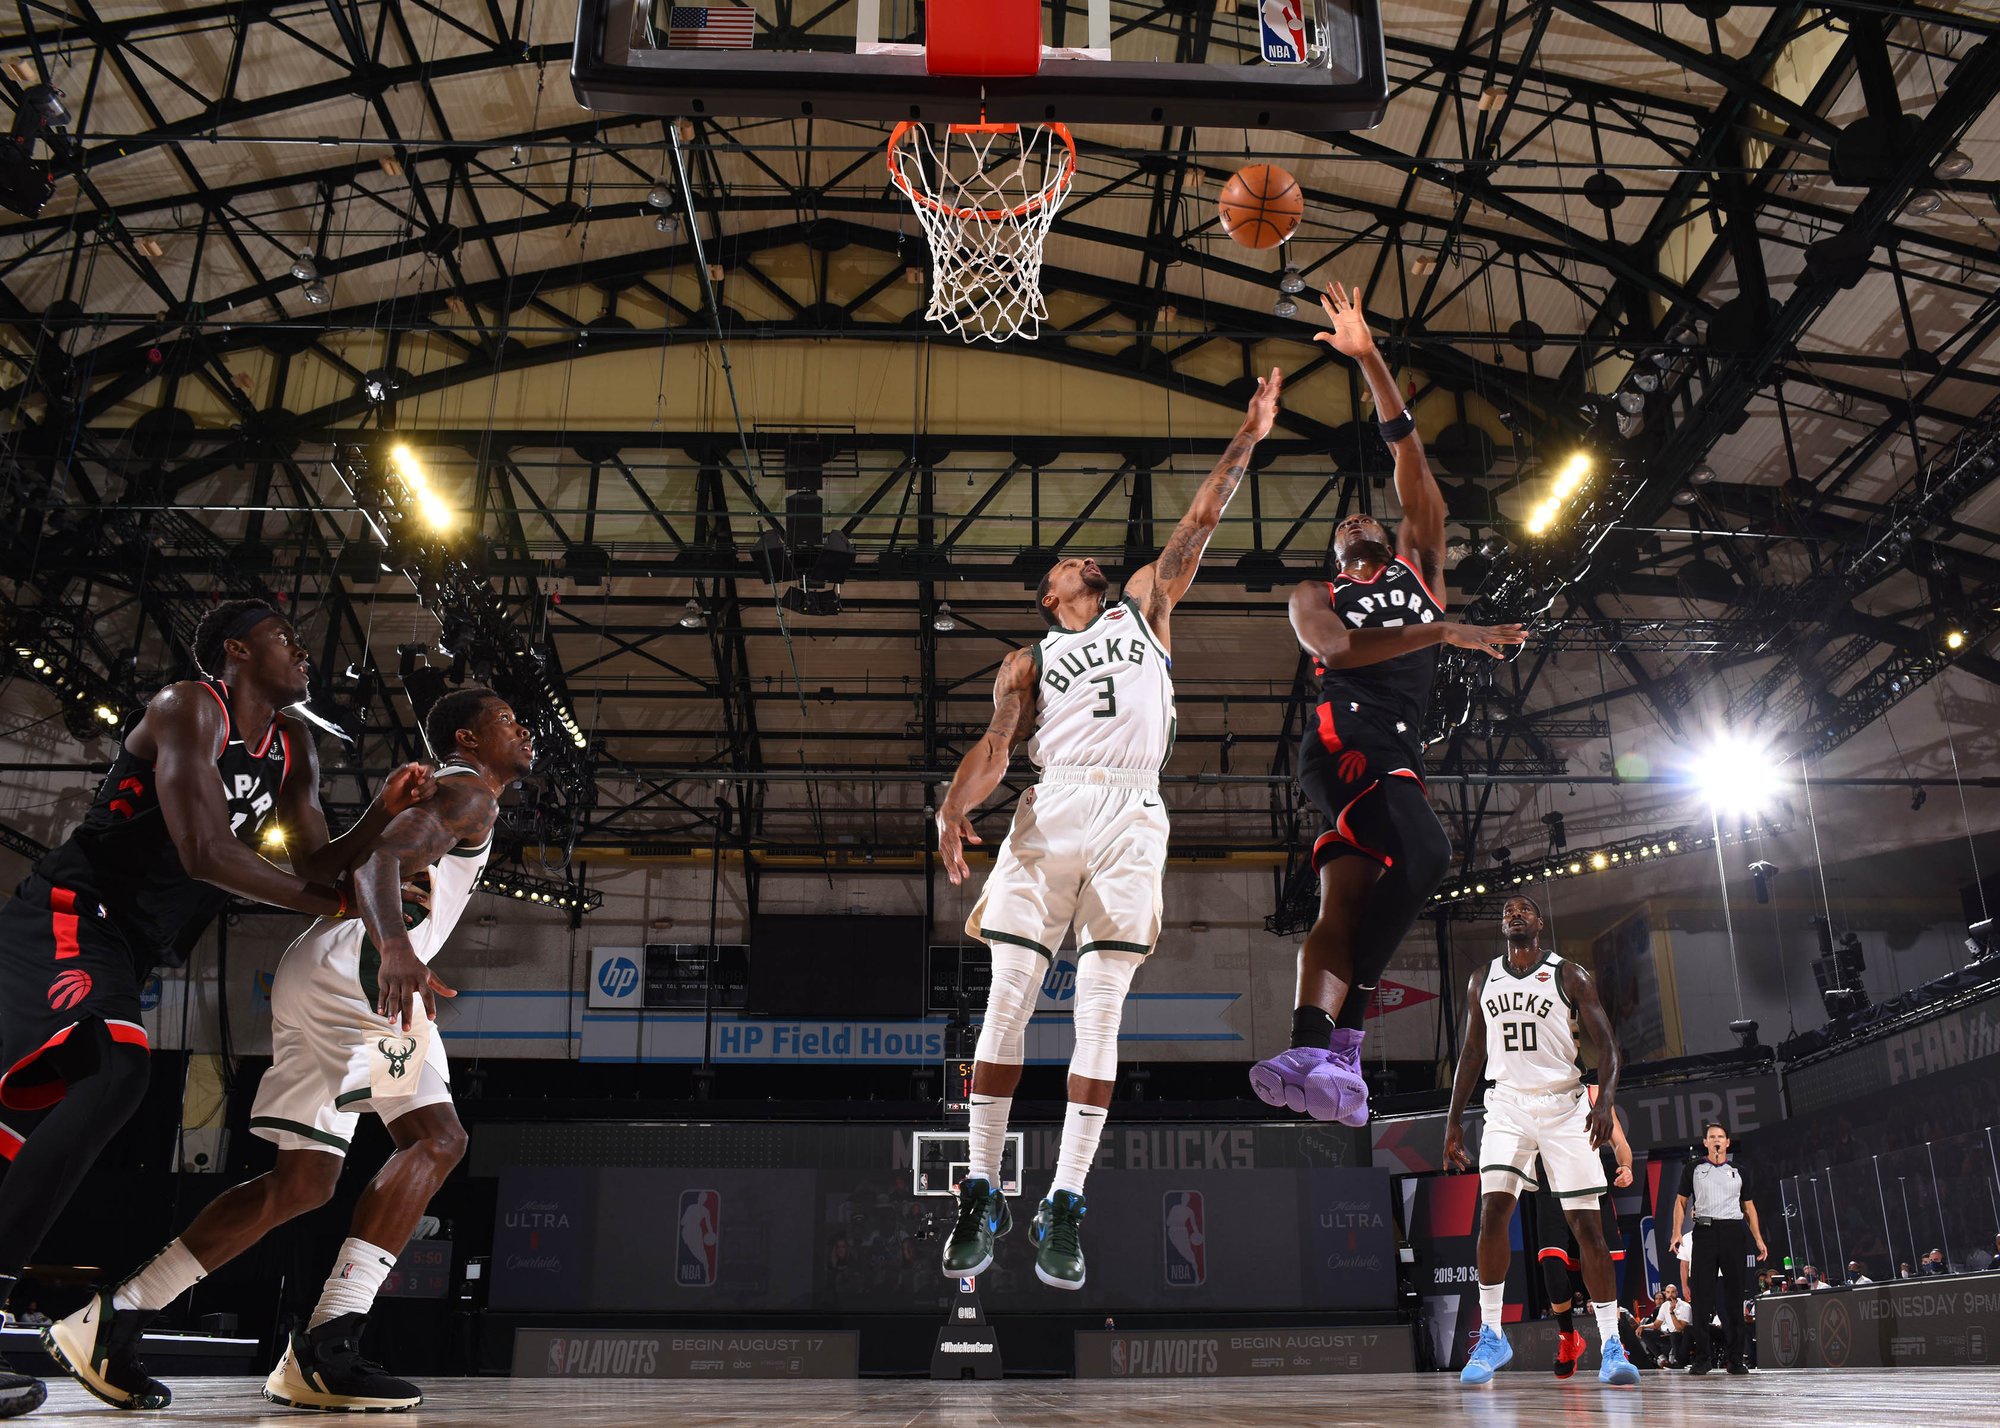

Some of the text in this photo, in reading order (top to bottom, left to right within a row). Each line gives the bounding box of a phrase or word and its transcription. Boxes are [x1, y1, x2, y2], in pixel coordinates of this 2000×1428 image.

[1268, 44, 1291, 58] NBA
[1044, 638, 1146, 694] BUCKS
[1088, 675, 1117, 719] 3
[602, 957, 636, 998] hp
[1485, 992, 1554, 1019] BUCKS
[720, 1026, 945, 1055] HP Field Hous
[1503, 1022, 1538, 1051] 20
[1637, 1087, 1761, 1143] TIRE
[1125, 1130, 1255, 1170] BUCKS
[505, 1213, 571, 1229] ULTRA
[1320, 1213, 1384, 1228] ULTRA
[1327, 1253, 1382, 1271] Courtside
[681, 1264, 701, 1280] NBA
[1171, 1264, 1191, 1280] NBA
[1434, 1266, 1468, 1283] 2019-20
[957, 1307, 977, 1319] @NBA
[1858, 1292, 1958, 1320] WEDNESDAY
[1231, 1335, 1378, 1349] BEGIN AUGUST 17
[1802, 1327, 1817, 1342] VS
[672, 1339, 824, 1351] BEGIN AUGUST 17
[940, 1341, 994, 1353] #WholeNewGame
[1890, 1337, 1927, 1356] ESPN
[565, 1339, 660, 1374] PLAYOFFS
[690, 1360, 725, 1370] ESPN
[733, 1359, 752, 1369] abc
[1129, 1339, 1219, 1374] PLAYOFFS
[1251, 1357, 1284, 1368] ESPN
[1293, 1356, 1312, 1366] abc
